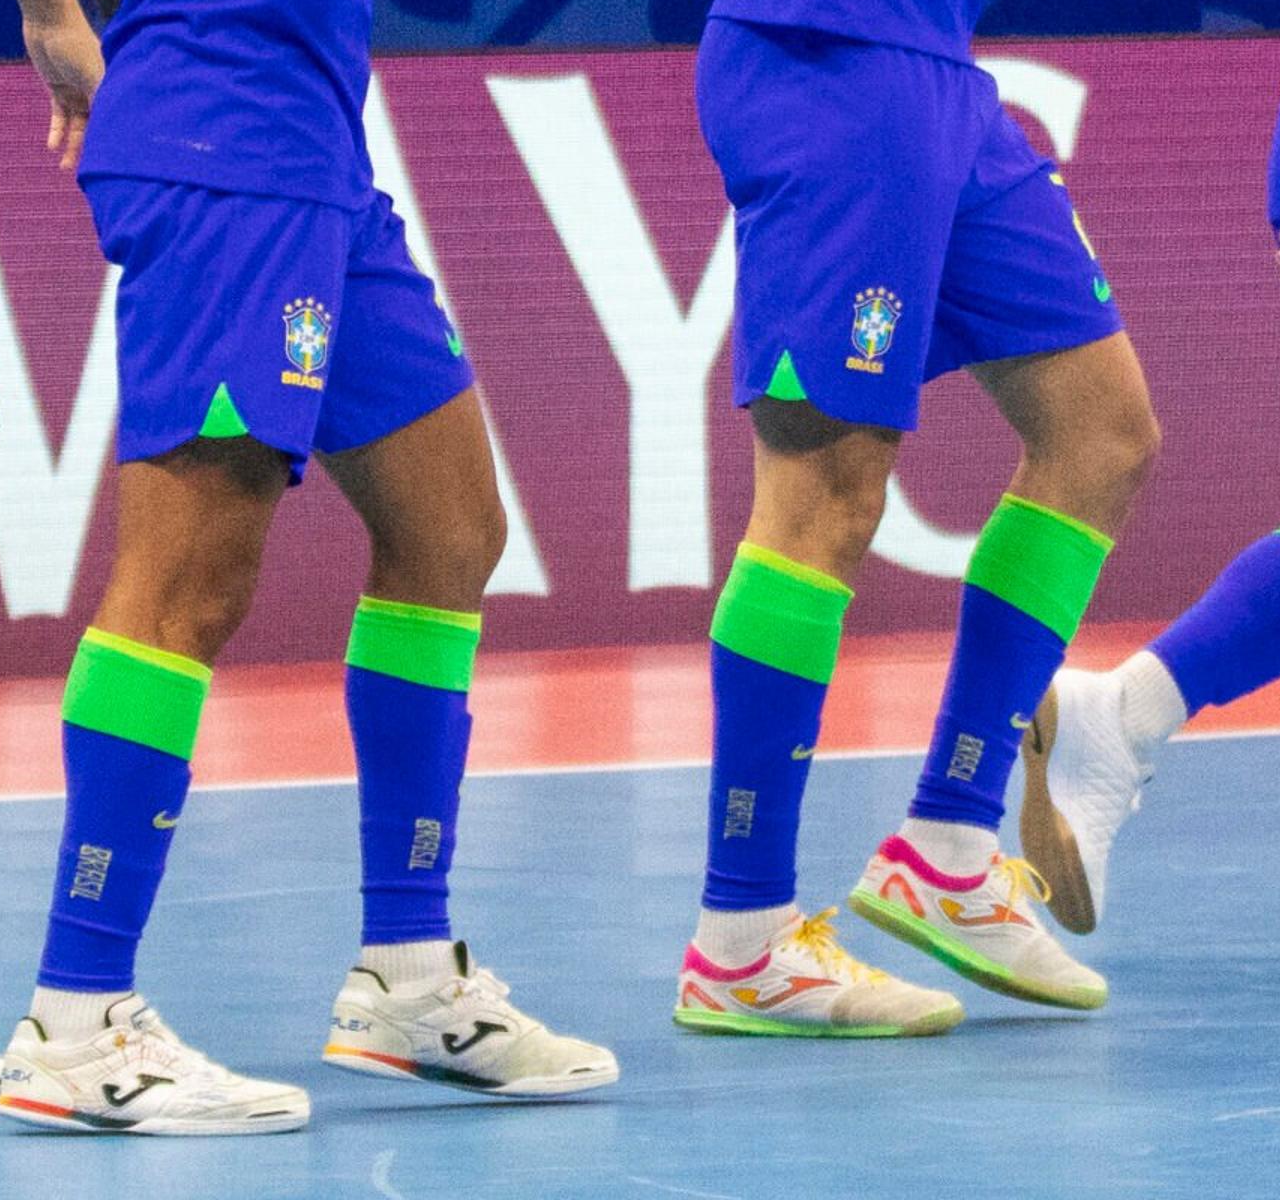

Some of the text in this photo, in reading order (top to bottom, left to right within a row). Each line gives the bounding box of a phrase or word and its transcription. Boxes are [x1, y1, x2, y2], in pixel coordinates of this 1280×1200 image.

[946, 732, 984, 783] BRASIL
[723, 788, 757, 840] BRASIL
[409, 818, 442, 871] BRASIL
[70, 844, 113, 901] BRASIL
